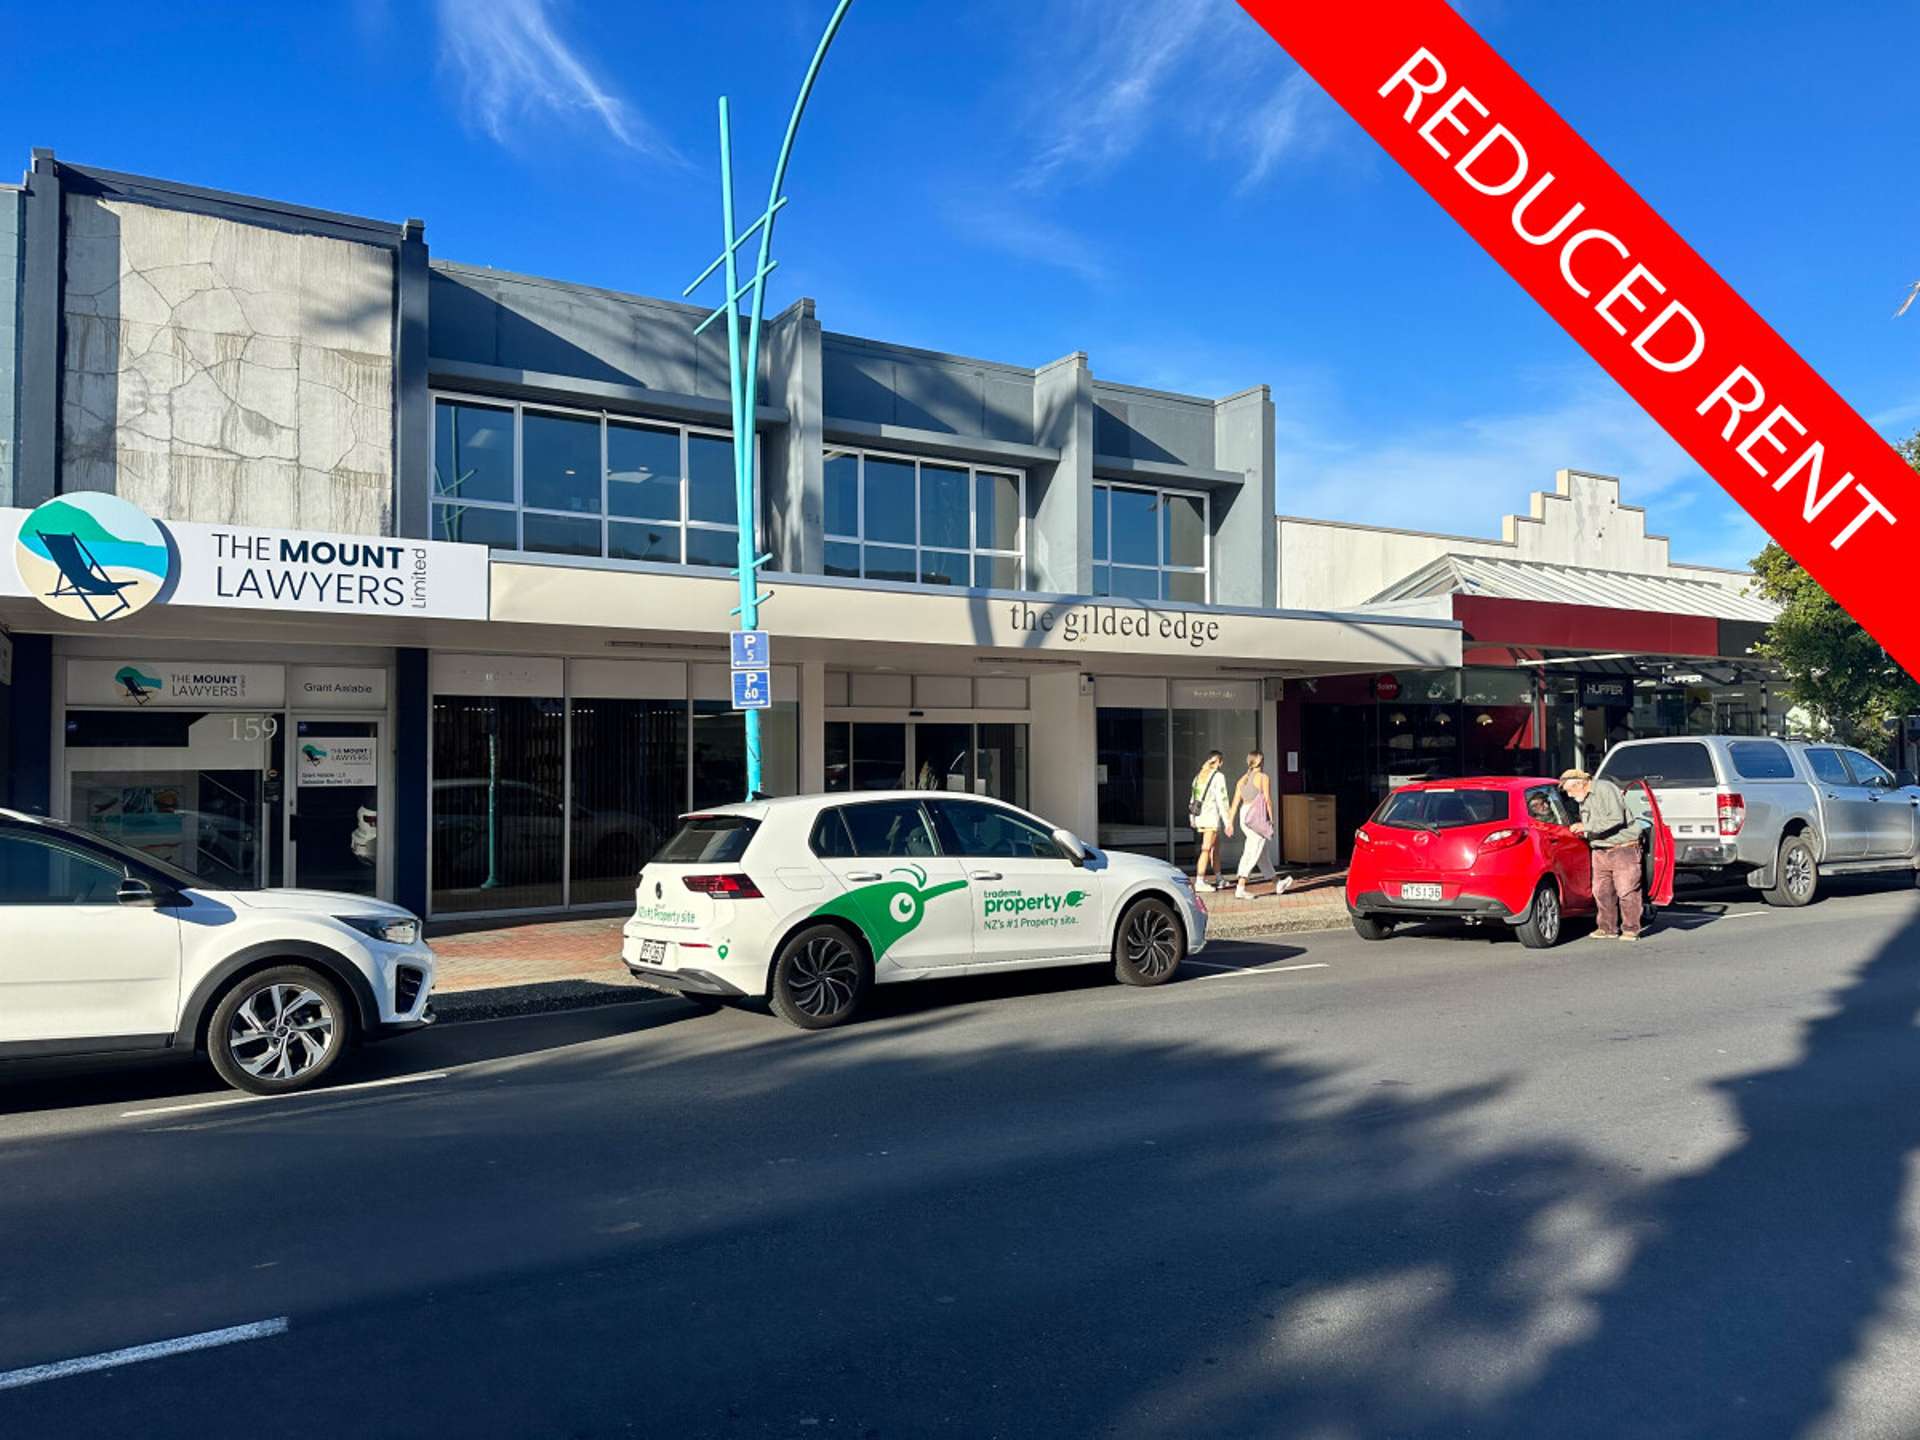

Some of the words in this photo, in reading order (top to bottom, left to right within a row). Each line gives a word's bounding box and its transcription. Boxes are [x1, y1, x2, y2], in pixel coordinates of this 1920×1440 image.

[211, 533, 271, 561] THE
[279, 538, 404, 569] MOUNT
[217, 566, 404, 606] LAWYERS
[411, 548, 427, 609] Limited
[1010, 600, 1055, 632] the
[1063, 604, 1150, 642] gilded
[1159, 611, 1219, 648] edge
[743, 634, 757, 649] P
[746, 649, 755, 661] 5
[170, 674, 190, 684] THE
[193, 675, 237, 684] MOUNT
[746, 673, 759, 688] P
[171, 685, 238, 697] LAWYERS
[303, 682, 333, 693] Grant
[744, 687, 759, 700] 60
[1586, 683, 1624, 696] HUFFER
[228, 717, 278, 741] 159
[984, 893, 1062, 917] property
[984, 919, 1005, 930] NZ's
[1006, 919, 1019, 929] #1
[1020, 917, 1059, 928] Property
